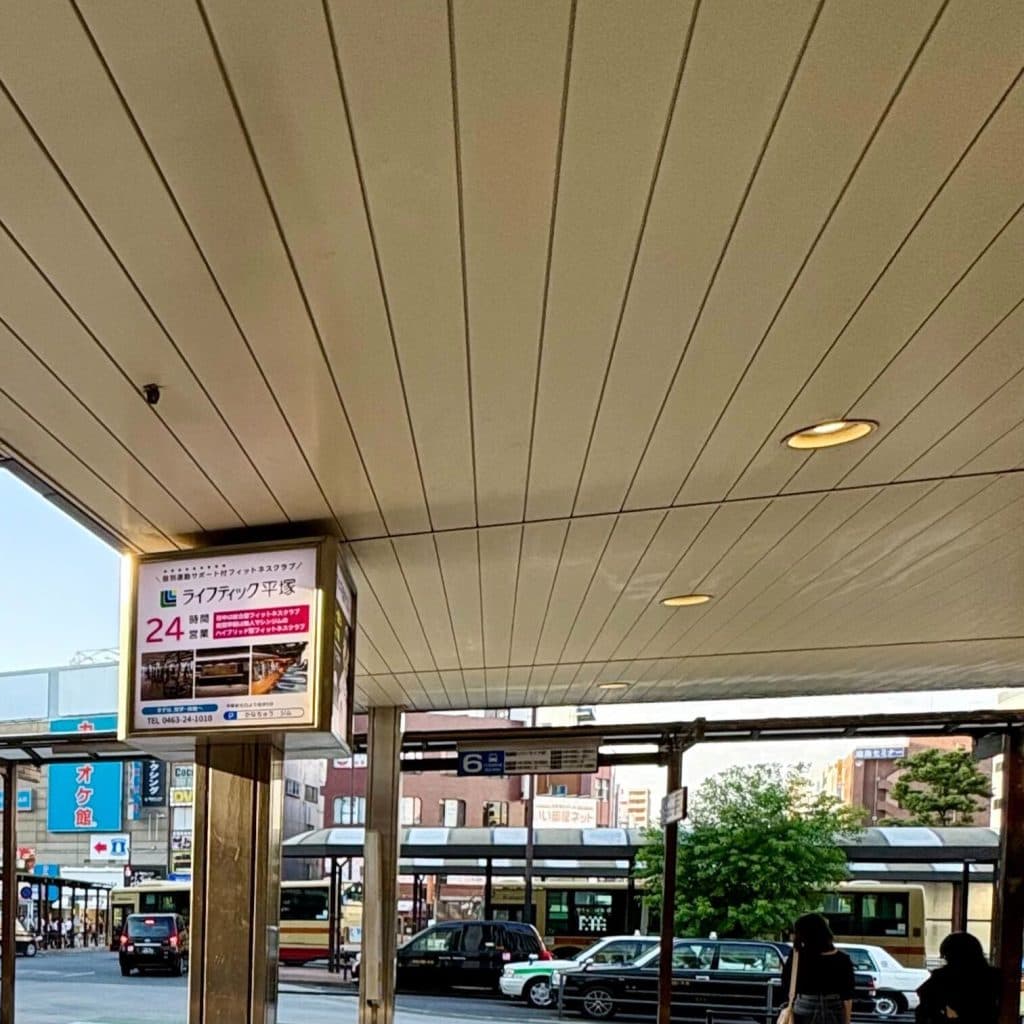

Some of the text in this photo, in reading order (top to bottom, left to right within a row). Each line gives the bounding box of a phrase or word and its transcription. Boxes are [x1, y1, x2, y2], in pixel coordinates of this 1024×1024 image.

[183, 578, 297, 605] ライフティック平塚
[189, 613, 209, 625] 時間
[146, 616, 184, 643] 24
[189, 628, 209, 640] 営業
[147, 717, 160, 725] TEL
[462, 753, 483, 773] 6
